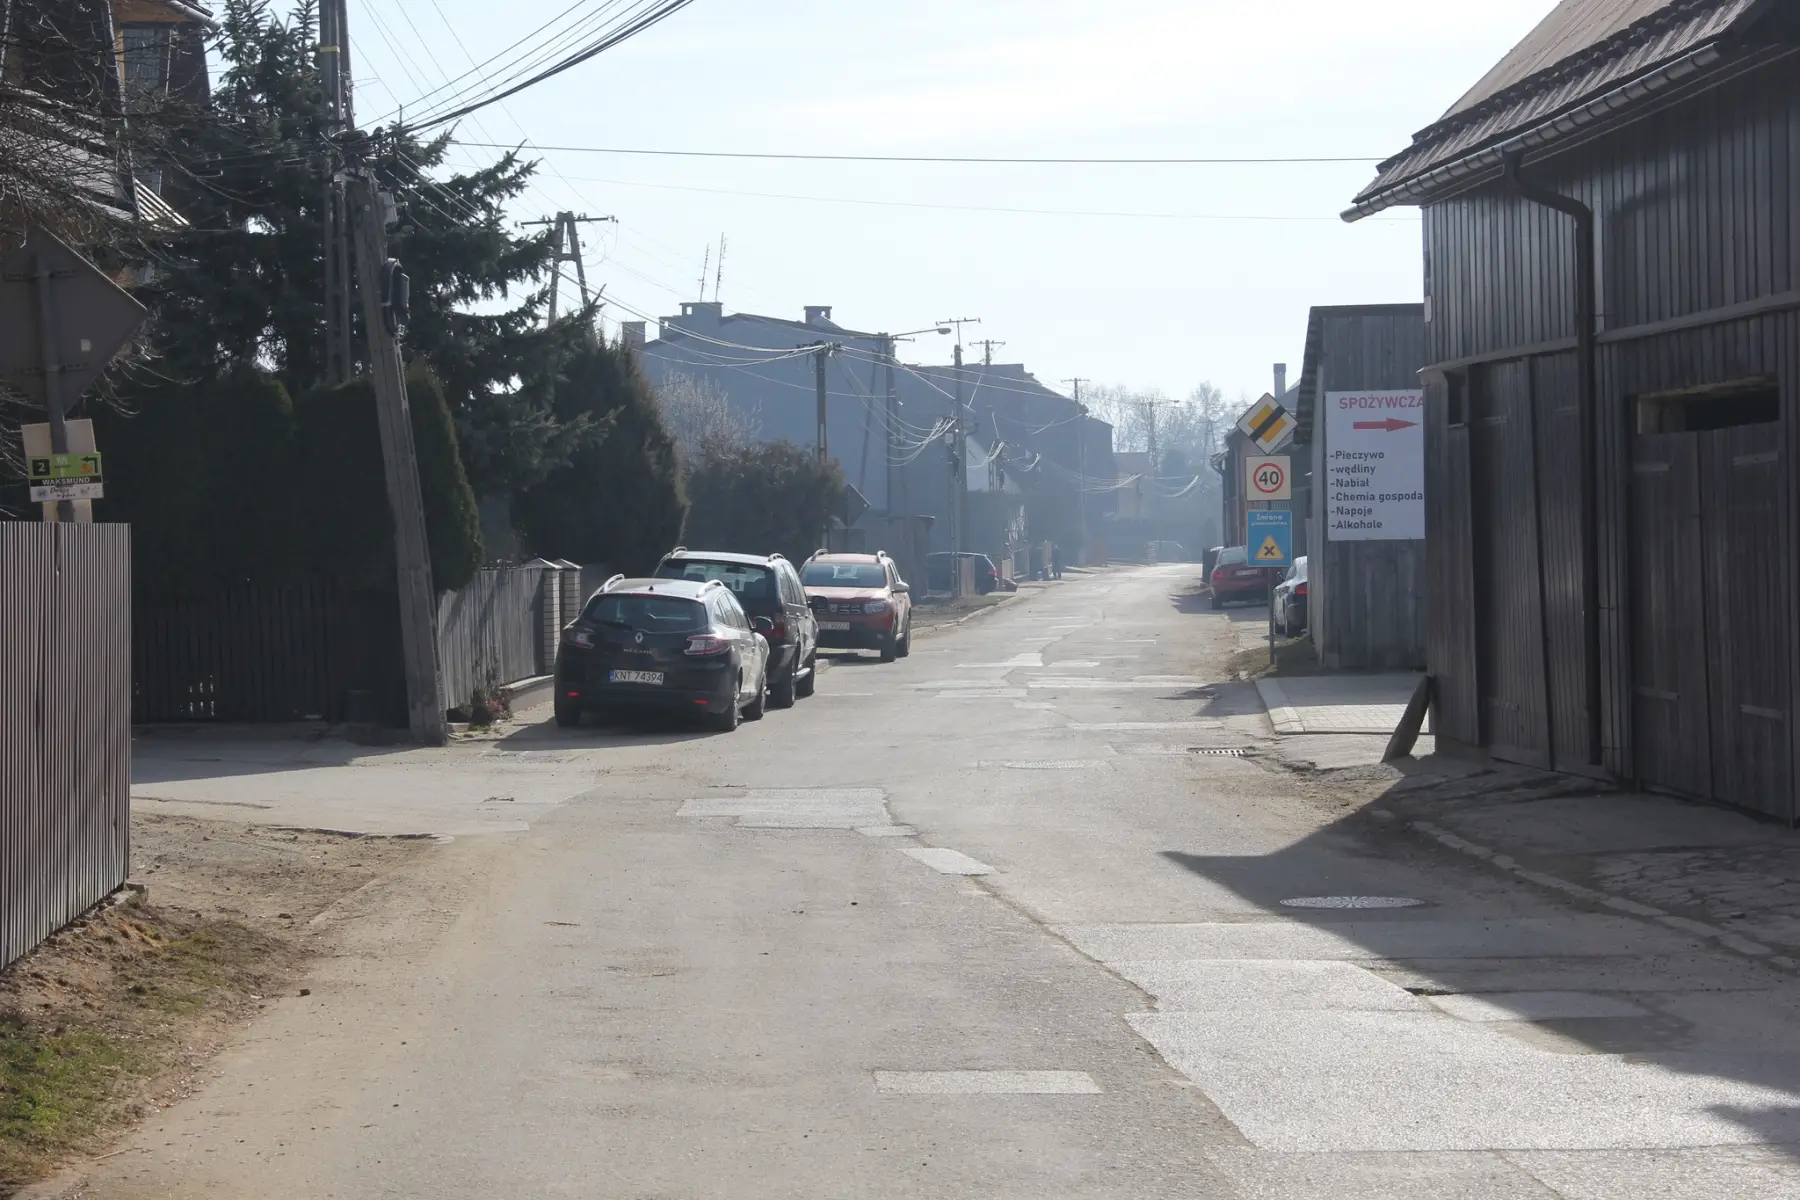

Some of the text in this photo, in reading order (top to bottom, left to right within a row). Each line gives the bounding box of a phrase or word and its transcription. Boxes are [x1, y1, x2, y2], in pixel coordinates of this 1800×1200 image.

[38, 462, 46, 472] 2
[42, 477, 90, 486] WAKSMUND
[1259, 471, 1279, 486] 40
[1378, 491, 1424, 503] gospoda
[614, 670, 662, 682] KNT 74394
